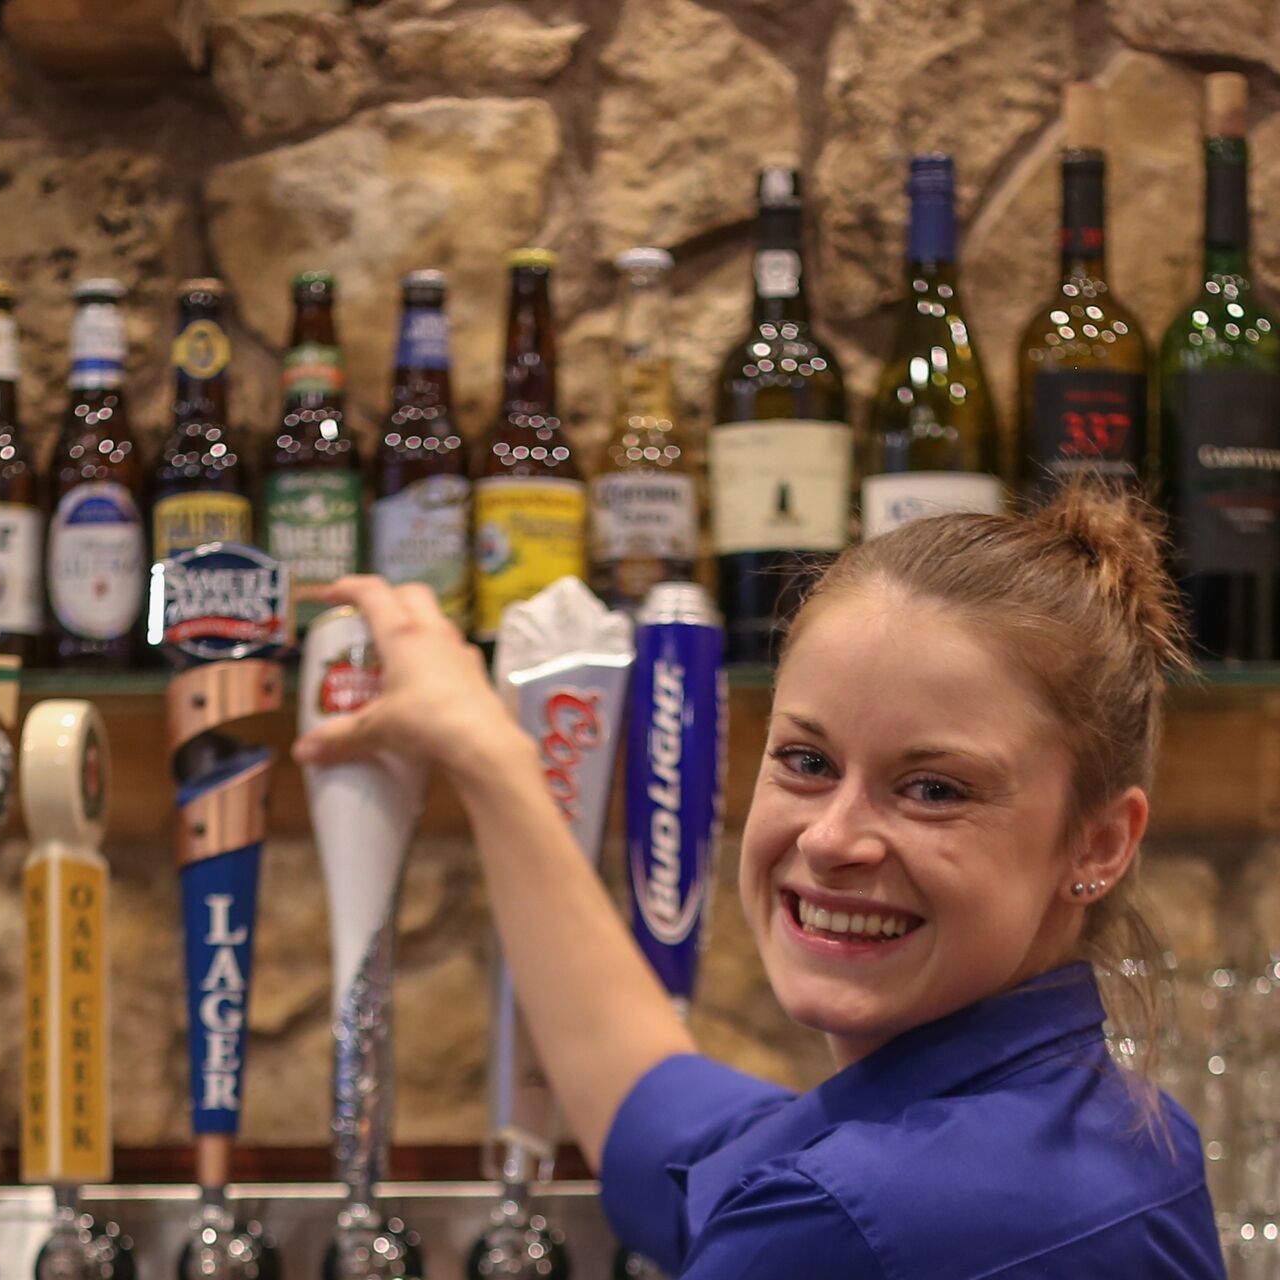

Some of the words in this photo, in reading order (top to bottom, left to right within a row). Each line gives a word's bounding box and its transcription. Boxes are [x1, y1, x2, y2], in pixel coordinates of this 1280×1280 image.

[544, 693, 603, 823] Coo
[70, 883, 94, 974] OAK
[70, 996, 93, 1150] CREEK
[199, 893, 248, 1111] LAGER
